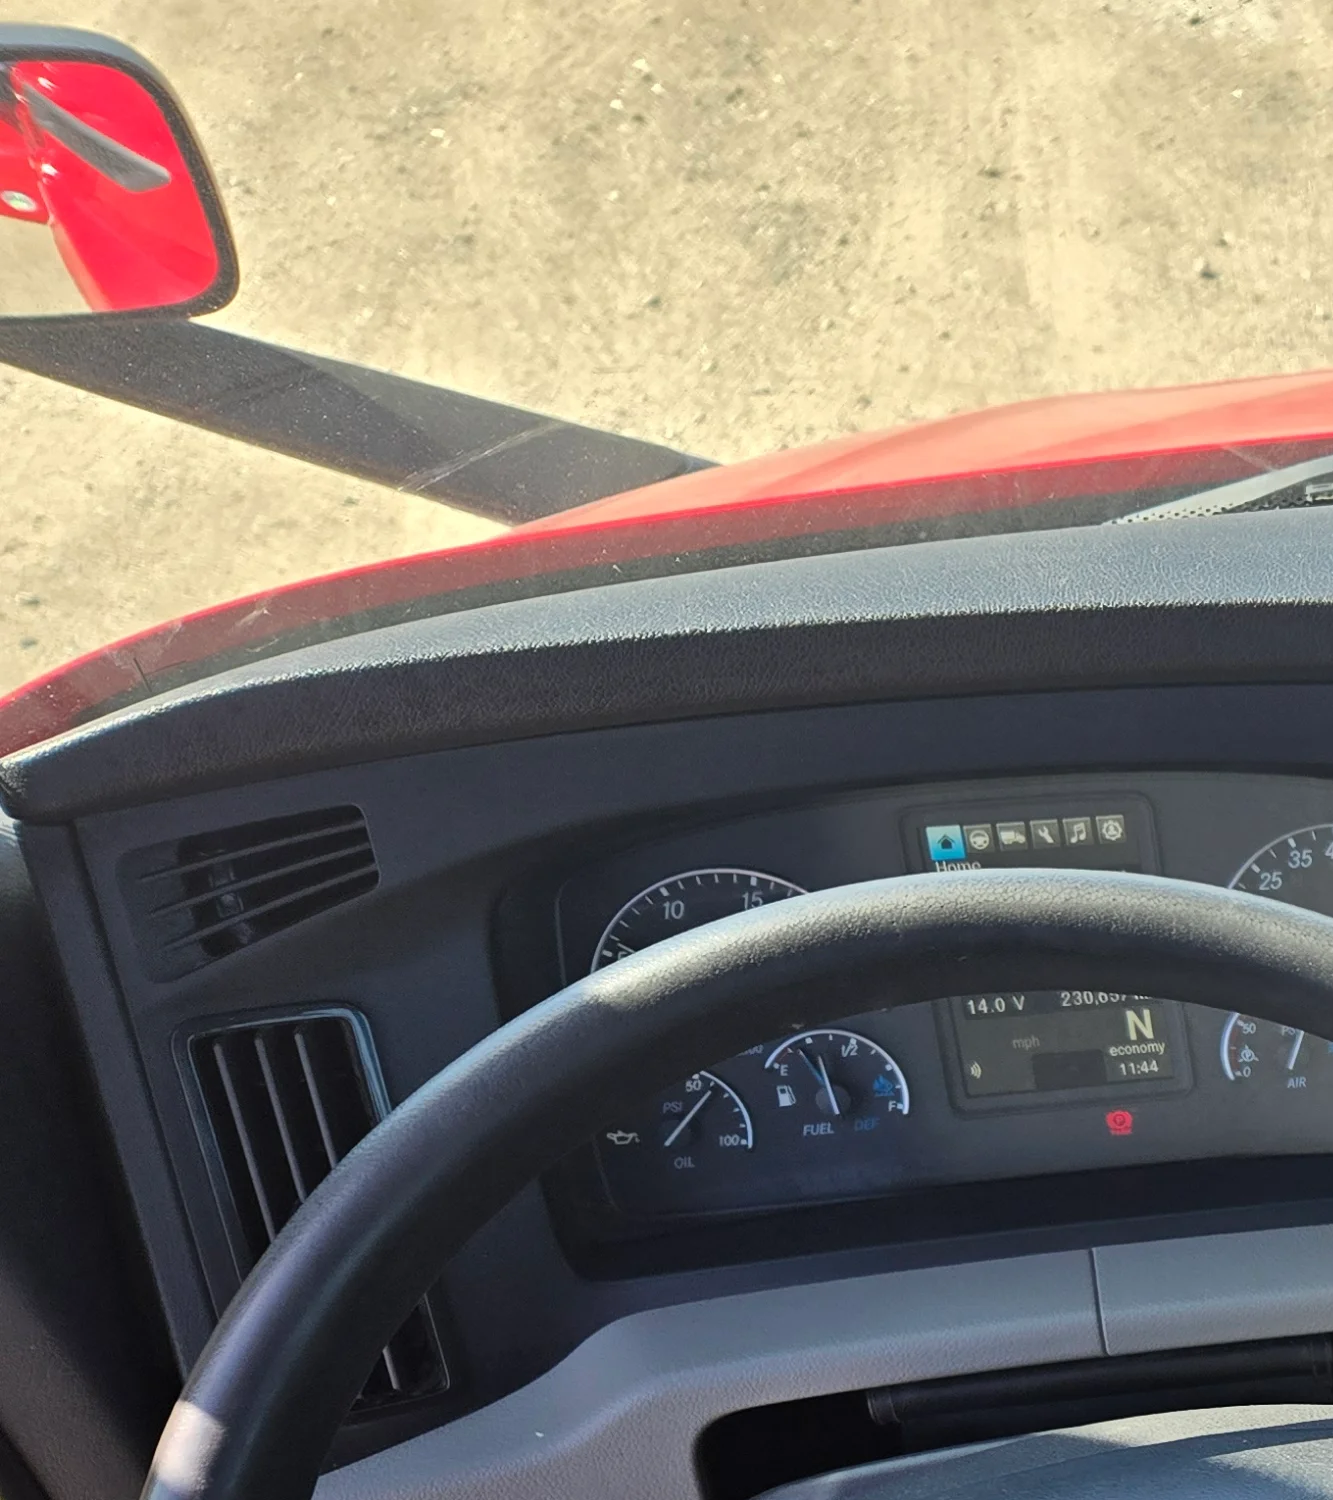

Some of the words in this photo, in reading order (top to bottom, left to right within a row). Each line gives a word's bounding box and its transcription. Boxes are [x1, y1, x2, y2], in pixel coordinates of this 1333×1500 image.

[1288, 849, 1313, 868] 35
[1259, 872, 1283, 890] 25
[743, 892, 764, 910] 15
[662, 901, 685, 920] 10
[967, 998, 1006, 1015] 14.0
[1012, 995, 1026, 1011] V
[1125, 1008, 1155, 1041] N
[1242, 1022, 1257, 1035] 50
[1012, 1035, 1041, 1050] mph
[1109, 1041, 1166, 1057] economy
[780, 1065, 789, 1077] E
[1119, 1060, 1159, 1076] 11:44
[1242, 1066, 1252, 1078] 0
[685, 1079, 702, 1093] 50
[1287, 1076, 1307, 1089] AIR
[663, 1101, 683, 1114] PSI
[888, 1101, 897, 1112] F
[803, 1122, 835, 1136] FUEL
[854, 1117, 880, 1132] DEF
[719, 1135, 740, 1148] 100
[674, 1156, 696, 1169] OIL
